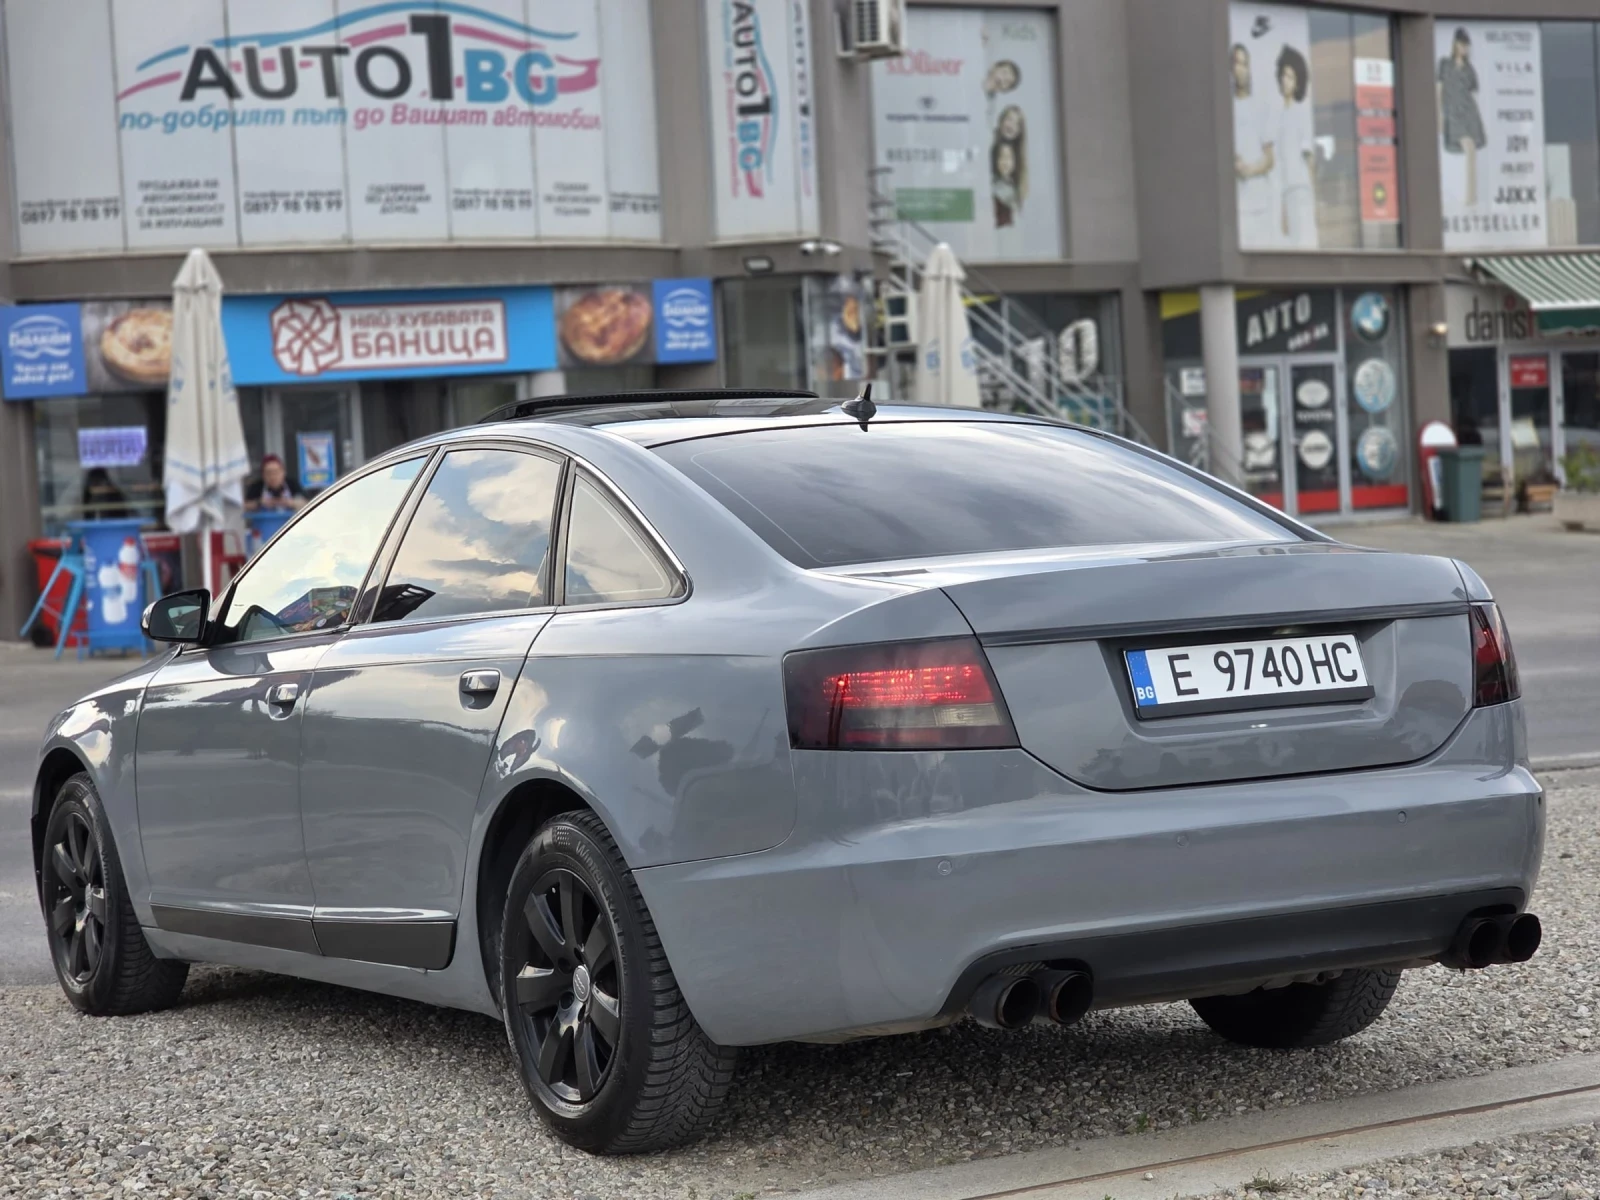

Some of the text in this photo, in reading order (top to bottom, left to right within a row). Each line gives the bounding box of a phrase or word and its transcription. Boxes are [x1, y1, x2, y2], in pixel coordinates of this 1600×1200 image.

[120, 103, 286, 134] по-добрият
[292, 107, 347, 126] път
[353, 107, 384, 130] до
[391, 103, 487, 126] Вашият
[886, 149, 974, 162] BESTSER
[351, 327, 495, 358] БАНИЦА
[1167, 642, 1359, 697] E 9740 HC
[1136, 686, 1155, 700] BG
